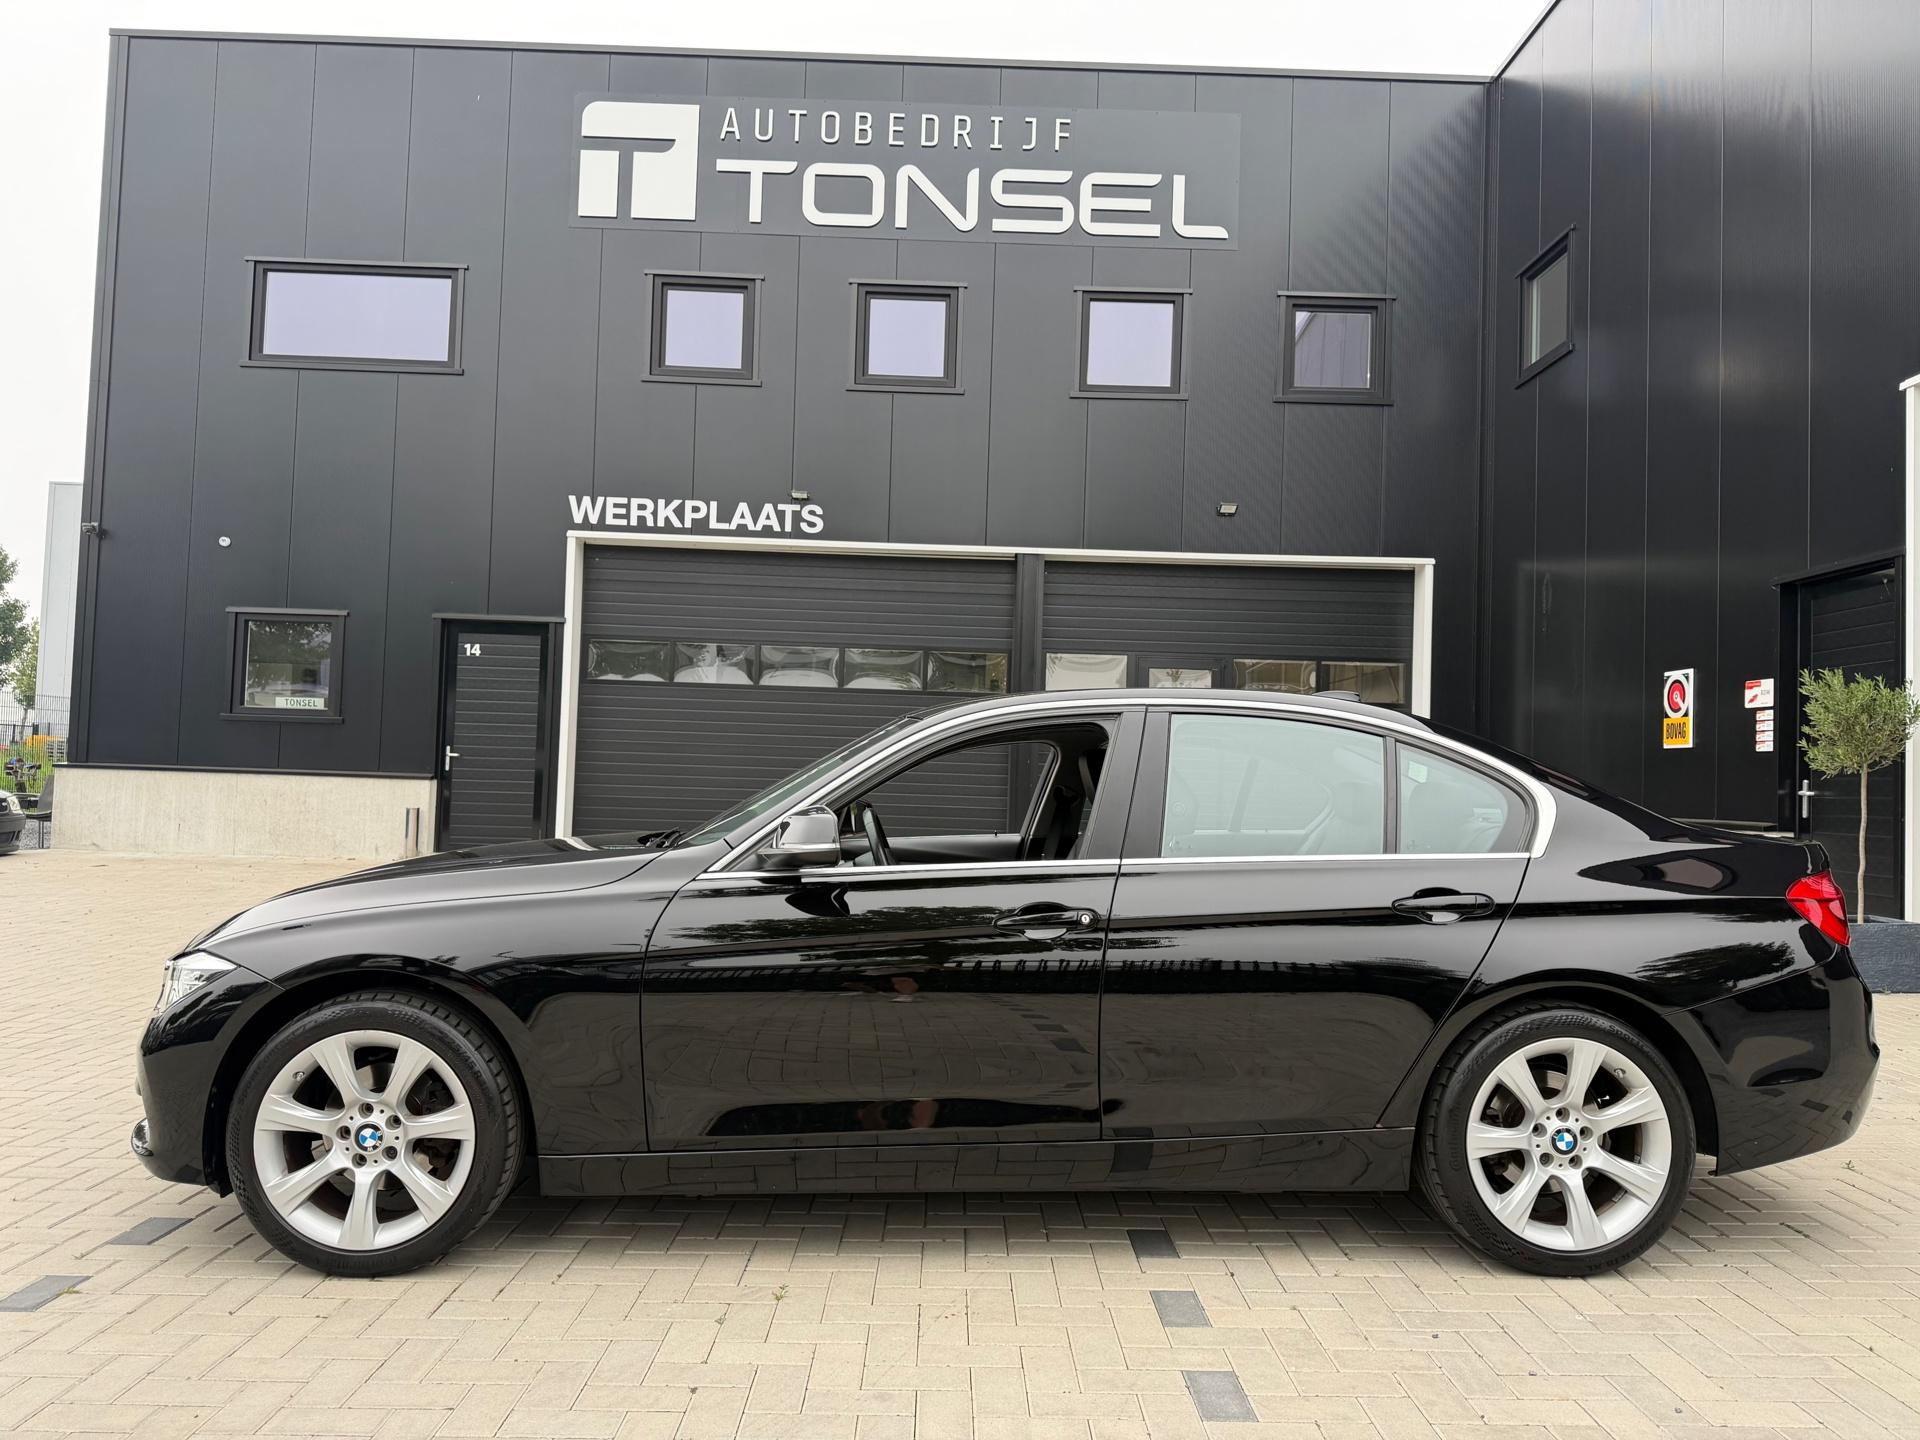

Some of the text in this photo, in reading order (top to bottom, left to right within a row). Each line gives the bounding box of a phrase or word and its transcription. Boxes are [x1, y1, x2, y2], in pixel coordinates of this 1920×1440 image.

[720, 106, 1073, 152] AUTOBEDRIJF
[716, 158, 1230, 240] TONSEL
[568, 494, 825, 534] WERKPLAATS
[464, 643, 481, 657] 14
[285, 698, 318, 707] TONSEL
[1665, 722, 1687, 740] BOVAG
